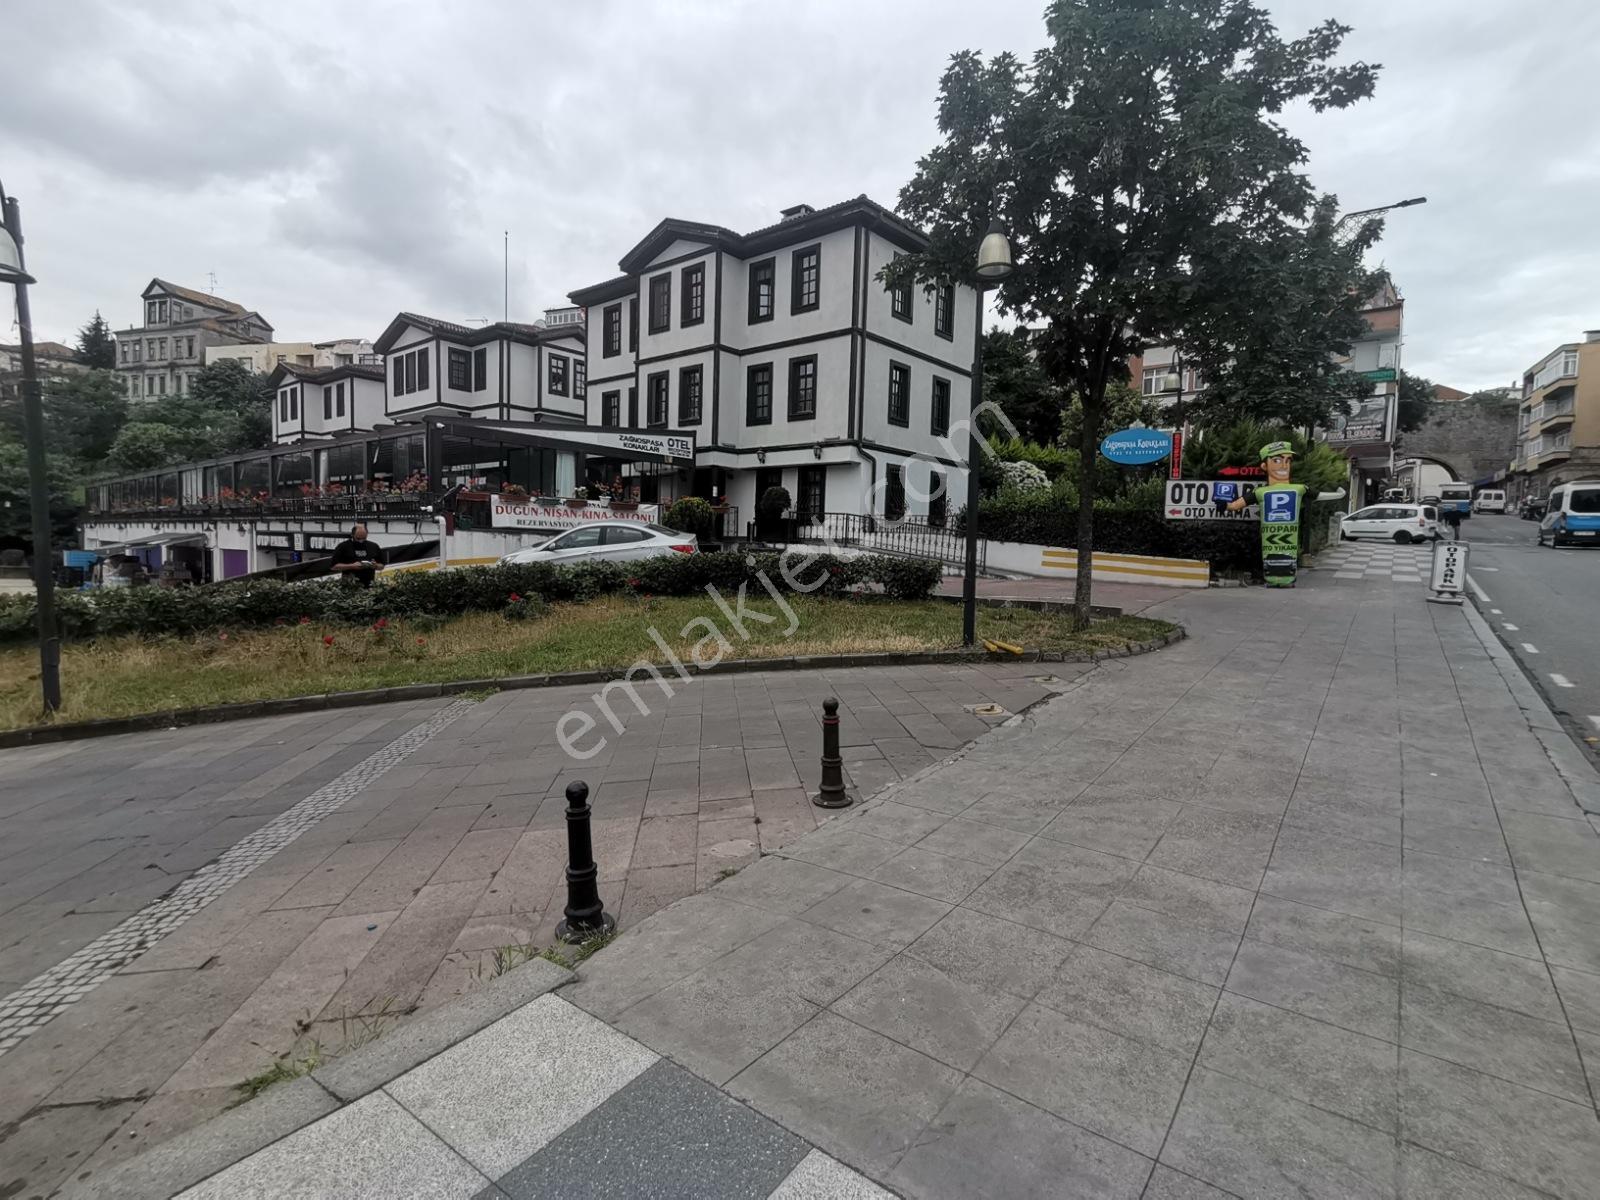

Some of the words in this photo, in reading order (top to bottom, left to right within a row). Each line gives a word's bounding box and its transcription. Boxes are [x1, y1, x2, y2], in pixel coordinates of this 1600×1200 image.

[667, 438, 690, 450] OTEL
[1170, 482, 1209, 504] OTO
[1271, 493, 1290, 509] P
[1184, 507, 1205, 517] OTO
[516, 519, 574, 528] REZERVASYON
[1443, 547, 1457, 584] OTOPARK
